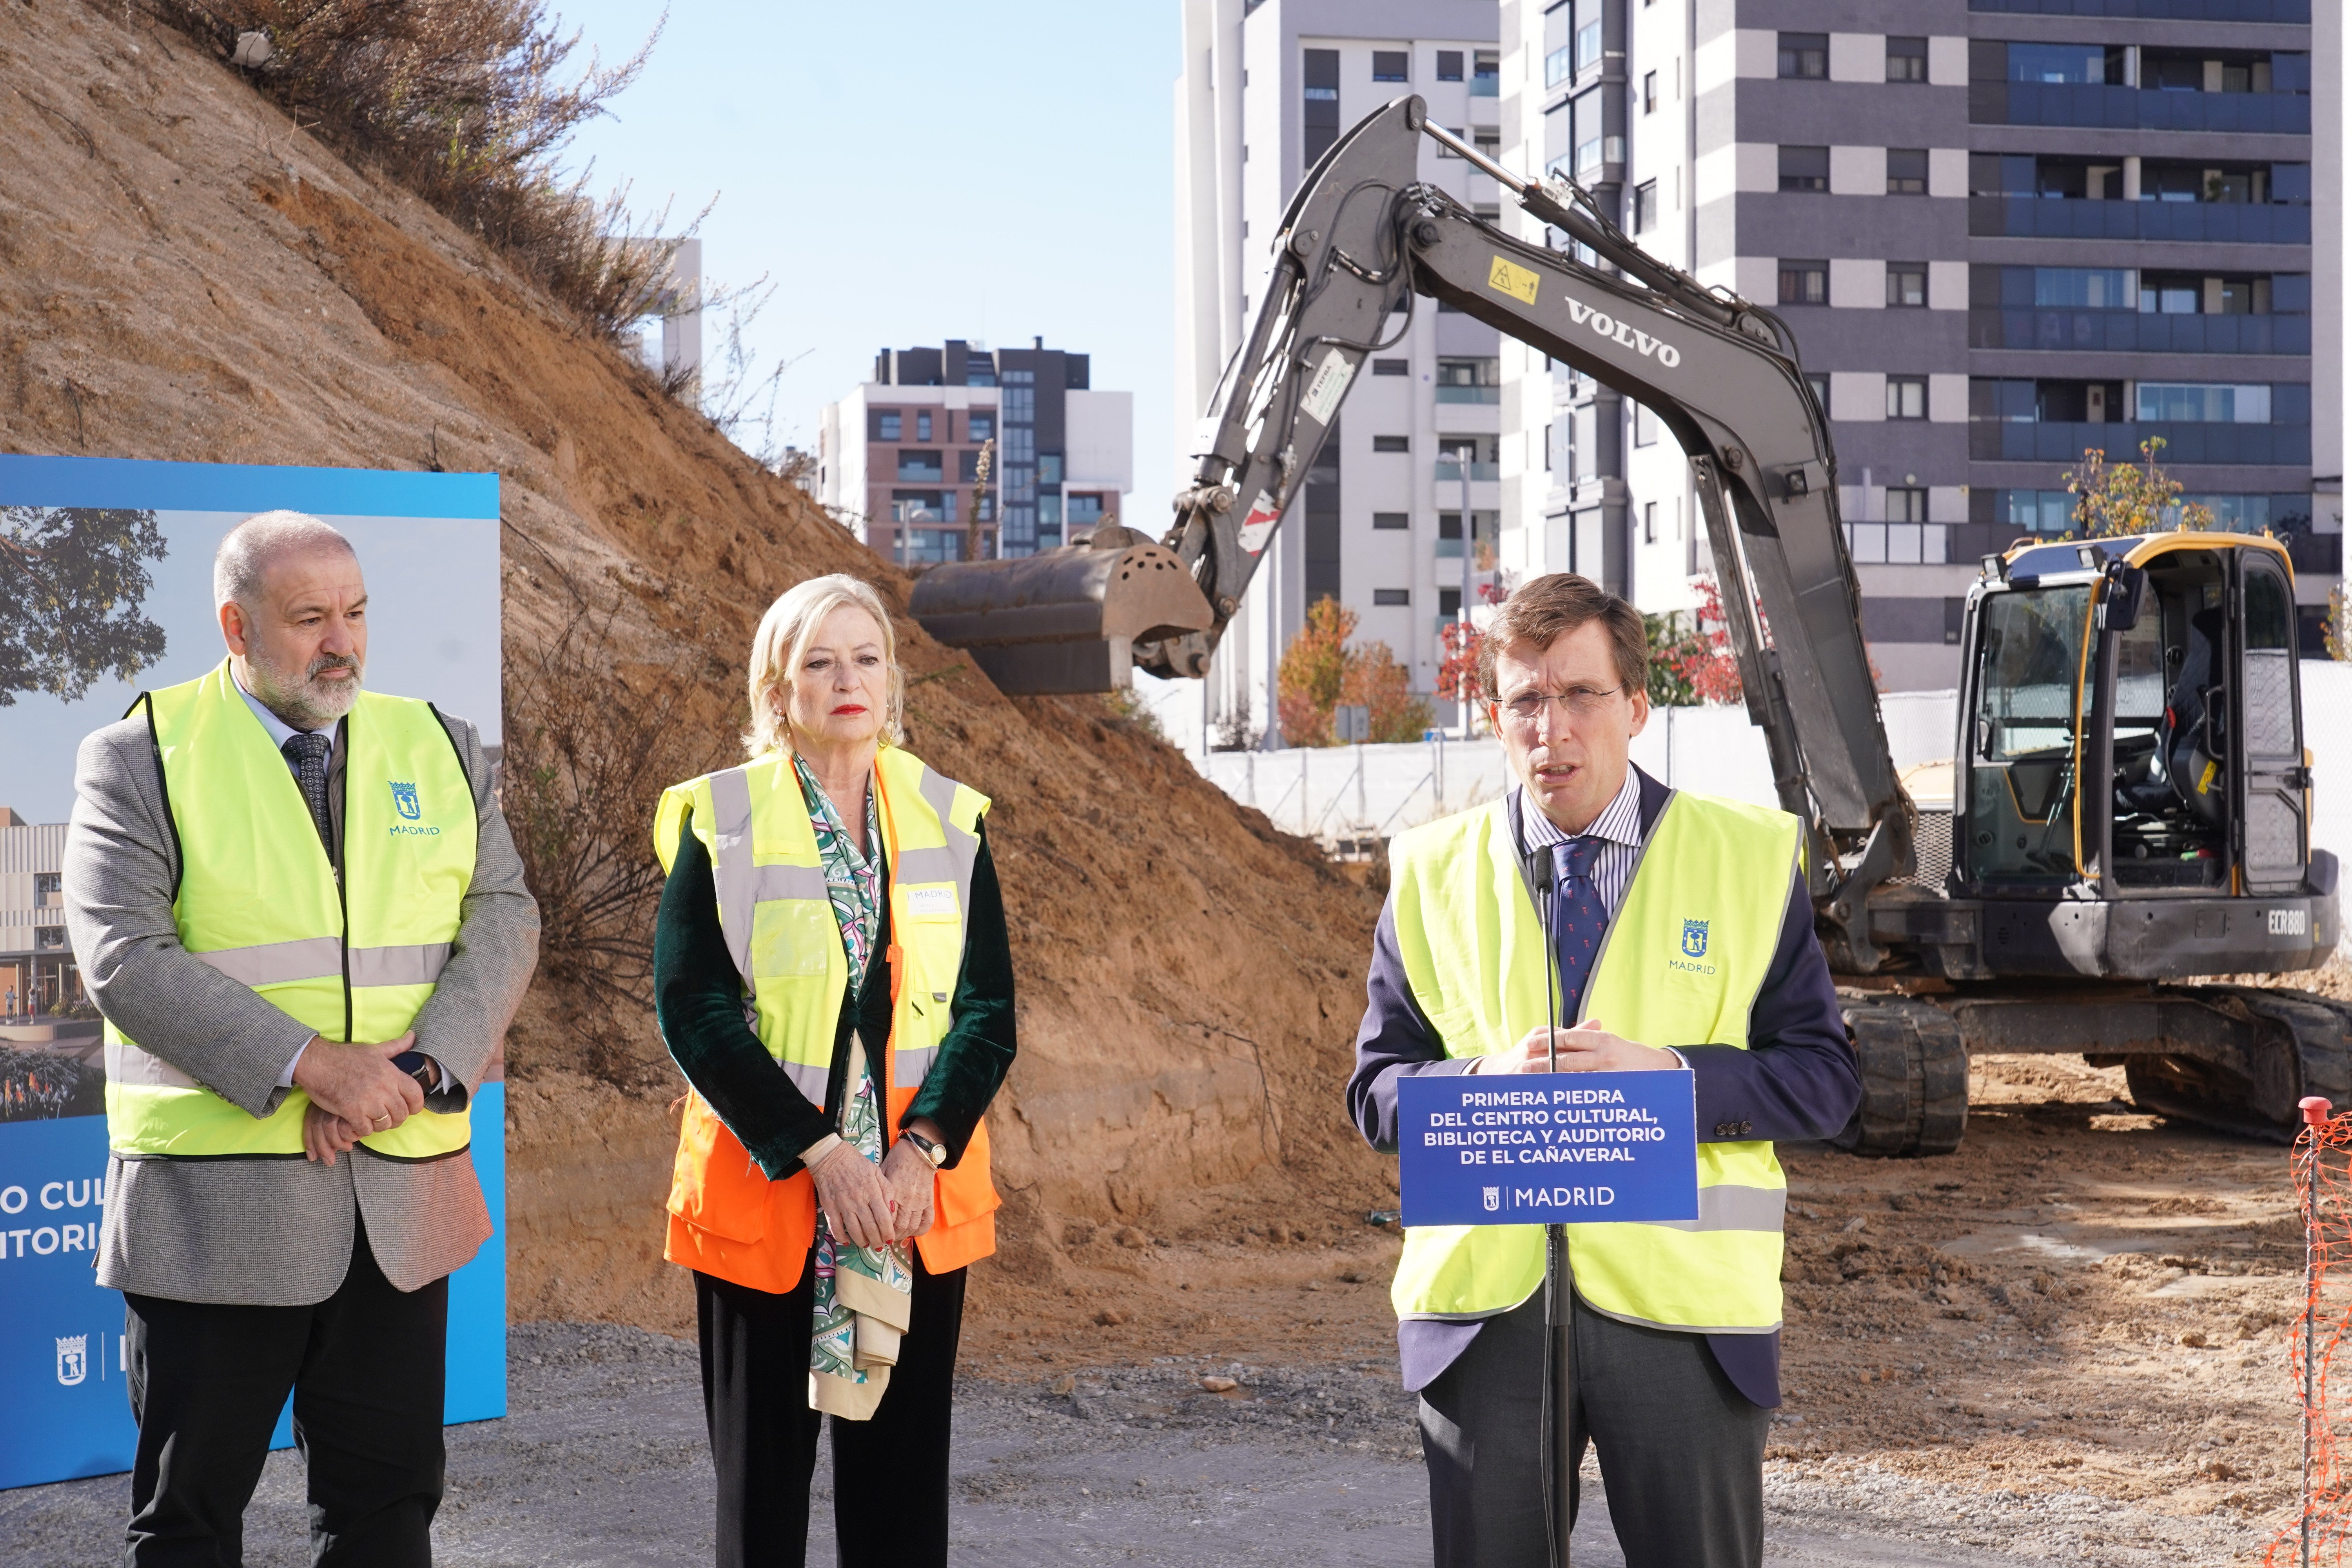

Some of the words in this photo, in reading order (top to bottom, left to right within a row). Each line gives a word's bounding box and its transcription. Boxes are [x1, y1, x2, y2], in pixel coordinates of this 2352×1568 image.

[1564, 296, 1680, 367] VOLVO
[389, 825, 440, 836] MADRID
[915, 890, 952, 899] MADRID
[1669, 960, 1715, 975] MADRID
[1462, 1091, 1548, 1107] PRIMERA
[1553, 1089, 1625, 1104] PIEDRA
[1431, 1112, 1467, 1127] DEL
[1472, 1111, 1549, 1125] CENTRO
[1554, 1108, 1658, 1124] CULTURAL,
[1425, 1130, 1537, 1146] BIBLIOTECA
[1540, 1130, 1553, 1143] Y
[1557, 1127, 1665, 1143] AUDITORIO
[1461, 1151, 1486, 1164] DE
[1492, 1150, 1514, 1164] EL
[1519, 1145, 1635, 1163] CAÑAVERAL
[1515, 1187, 1615, 1207] MADRID
